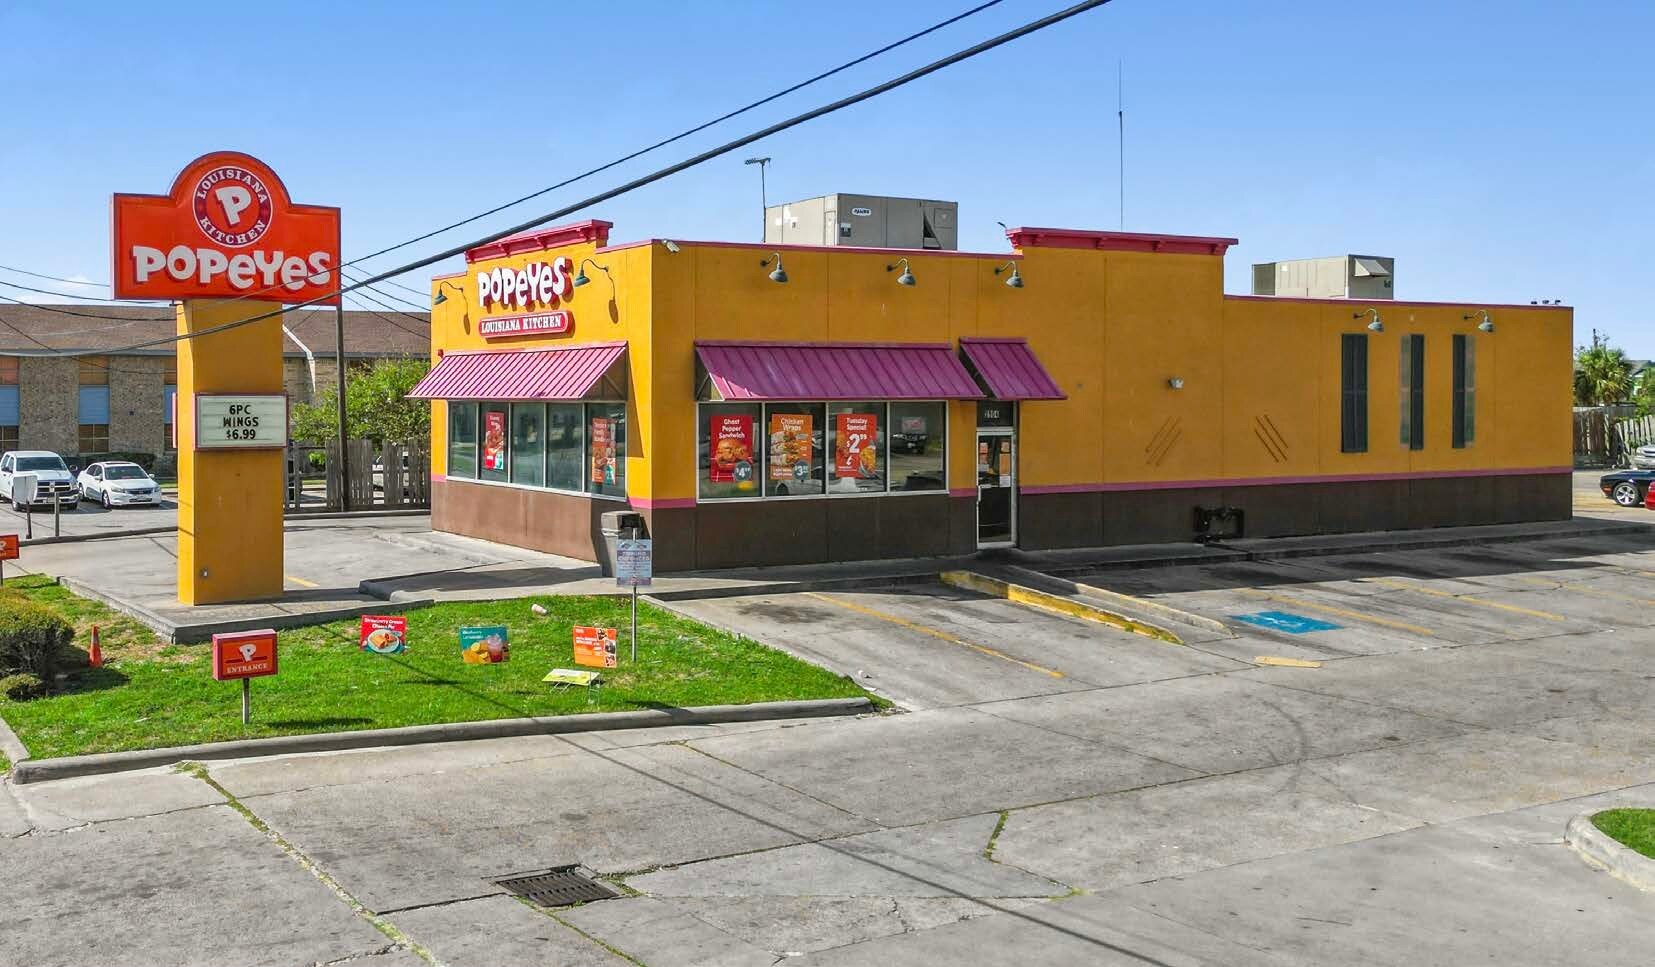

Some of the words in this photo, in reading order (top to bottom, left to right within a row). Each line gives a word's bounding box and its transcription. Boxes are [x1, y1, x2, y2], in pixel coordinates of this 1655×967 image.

[196, 167, 268, 204] LOUISIANA
[214, 185, 252, 225] P
[199, 215, 266, 245] KITCHEN
[481, 319, 521, 334] LOUISIANA
[522, 314, 562, 330] KITCHEN
[229, 404, 252, 415] 6PC
[223, 416, 259, 428] WINGS
[226, 429, 256, 440] $6.99
[238, 643, 257, 662] P
[226, 663, 269, 674] ENTRANCE
